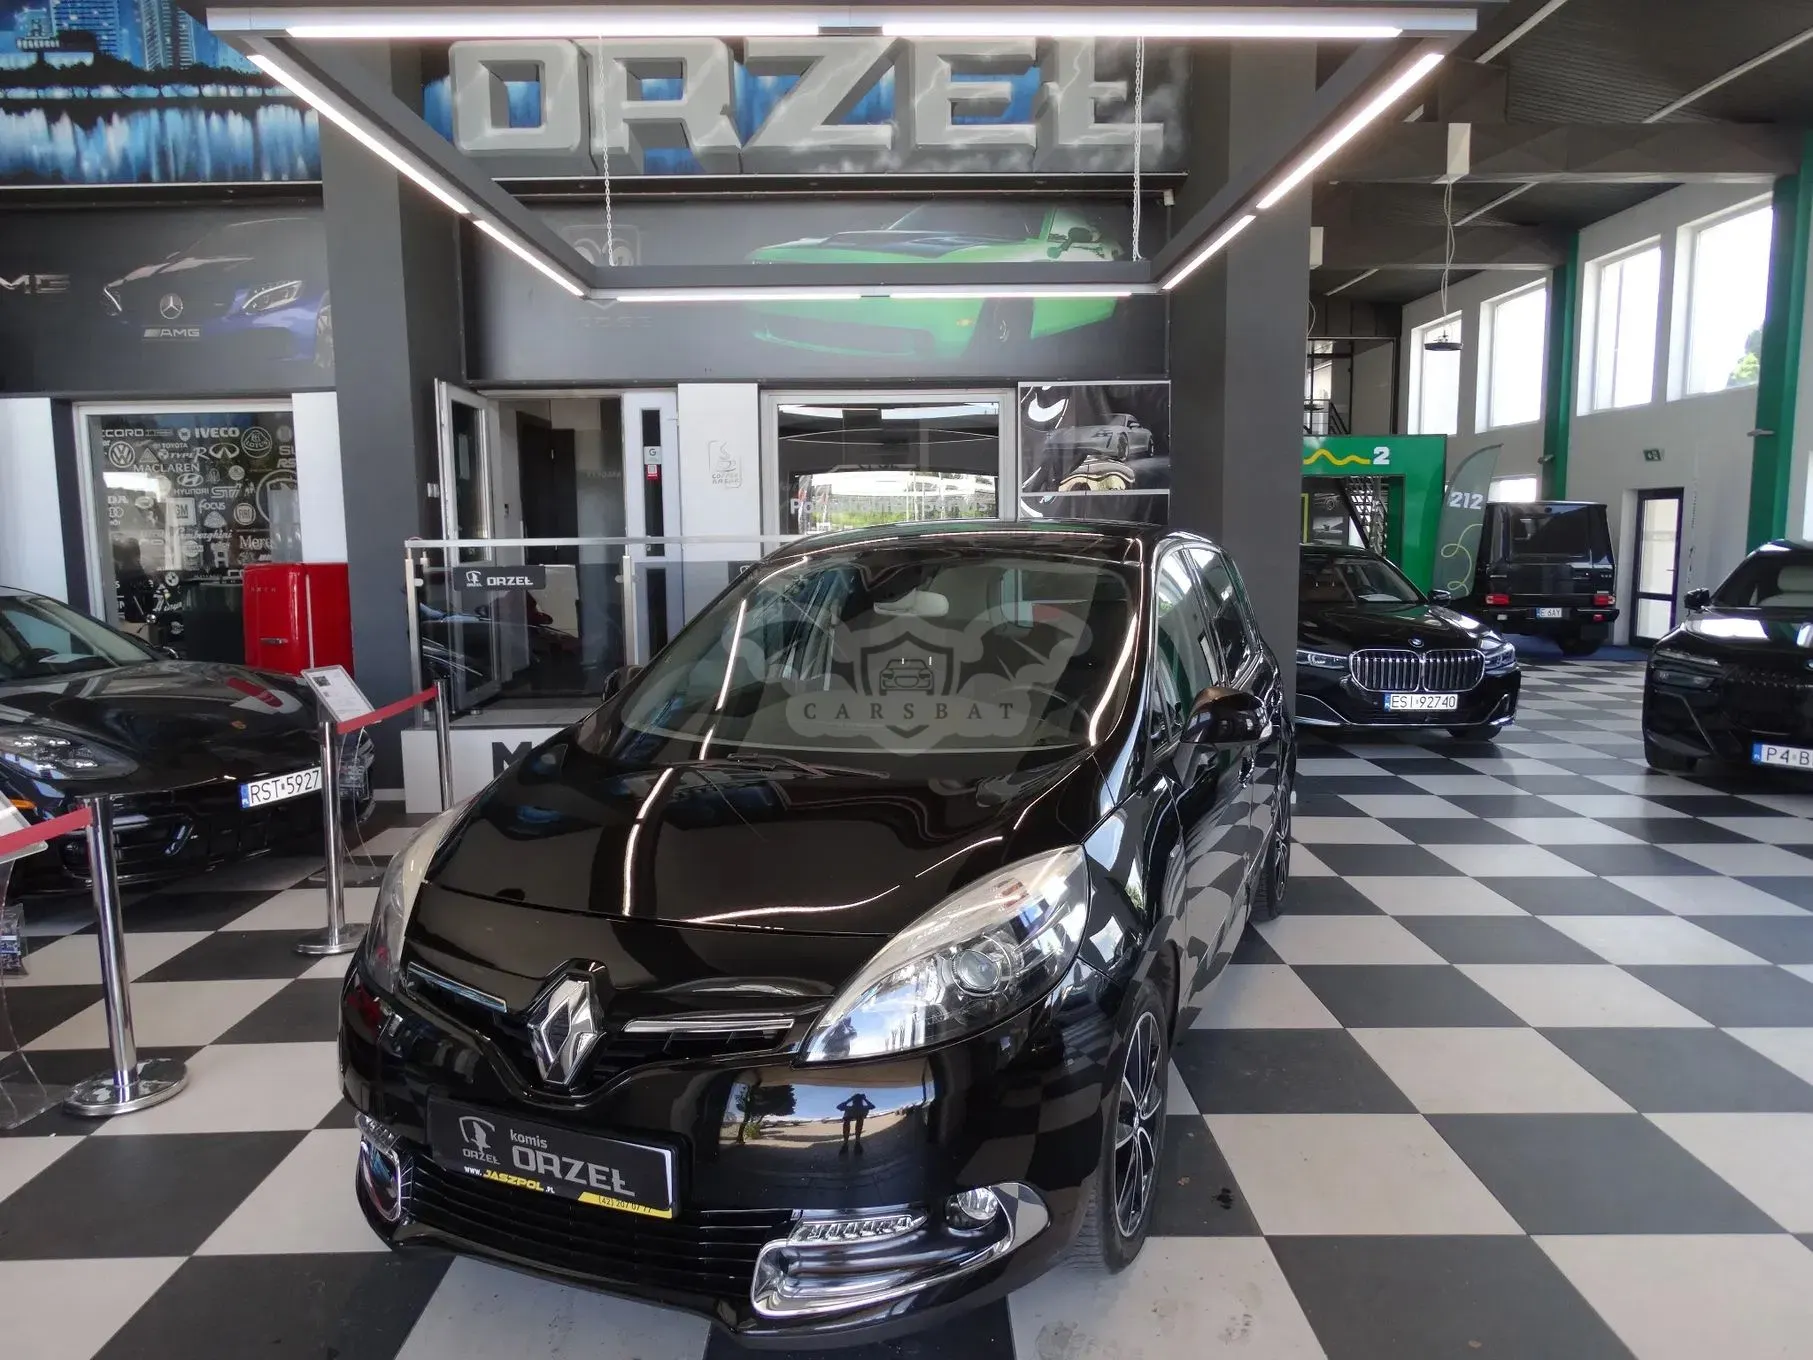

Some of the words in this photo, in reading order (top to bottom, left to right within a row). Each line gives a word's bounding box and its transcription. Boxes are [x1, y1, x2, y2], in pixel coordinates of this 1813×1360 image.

[159, 328, 200, 338] AMG
[194, 427, 241, 439] IVECO
[1373, 446, 1390, 465] 2
[132, 463, 200, 473] MACLAREN
[1449, 491, 1484, 510] 212
[486, 575, 534, 587] ORZEŁ
[1419, 696, 1456, 708] 92740
[250, 779, 281, 804] RST
[286, 770, 320, 796] 5927
[509, 1128, 549, 1149] komis
[512, 1145, 636, 1197] ORZEŁ
